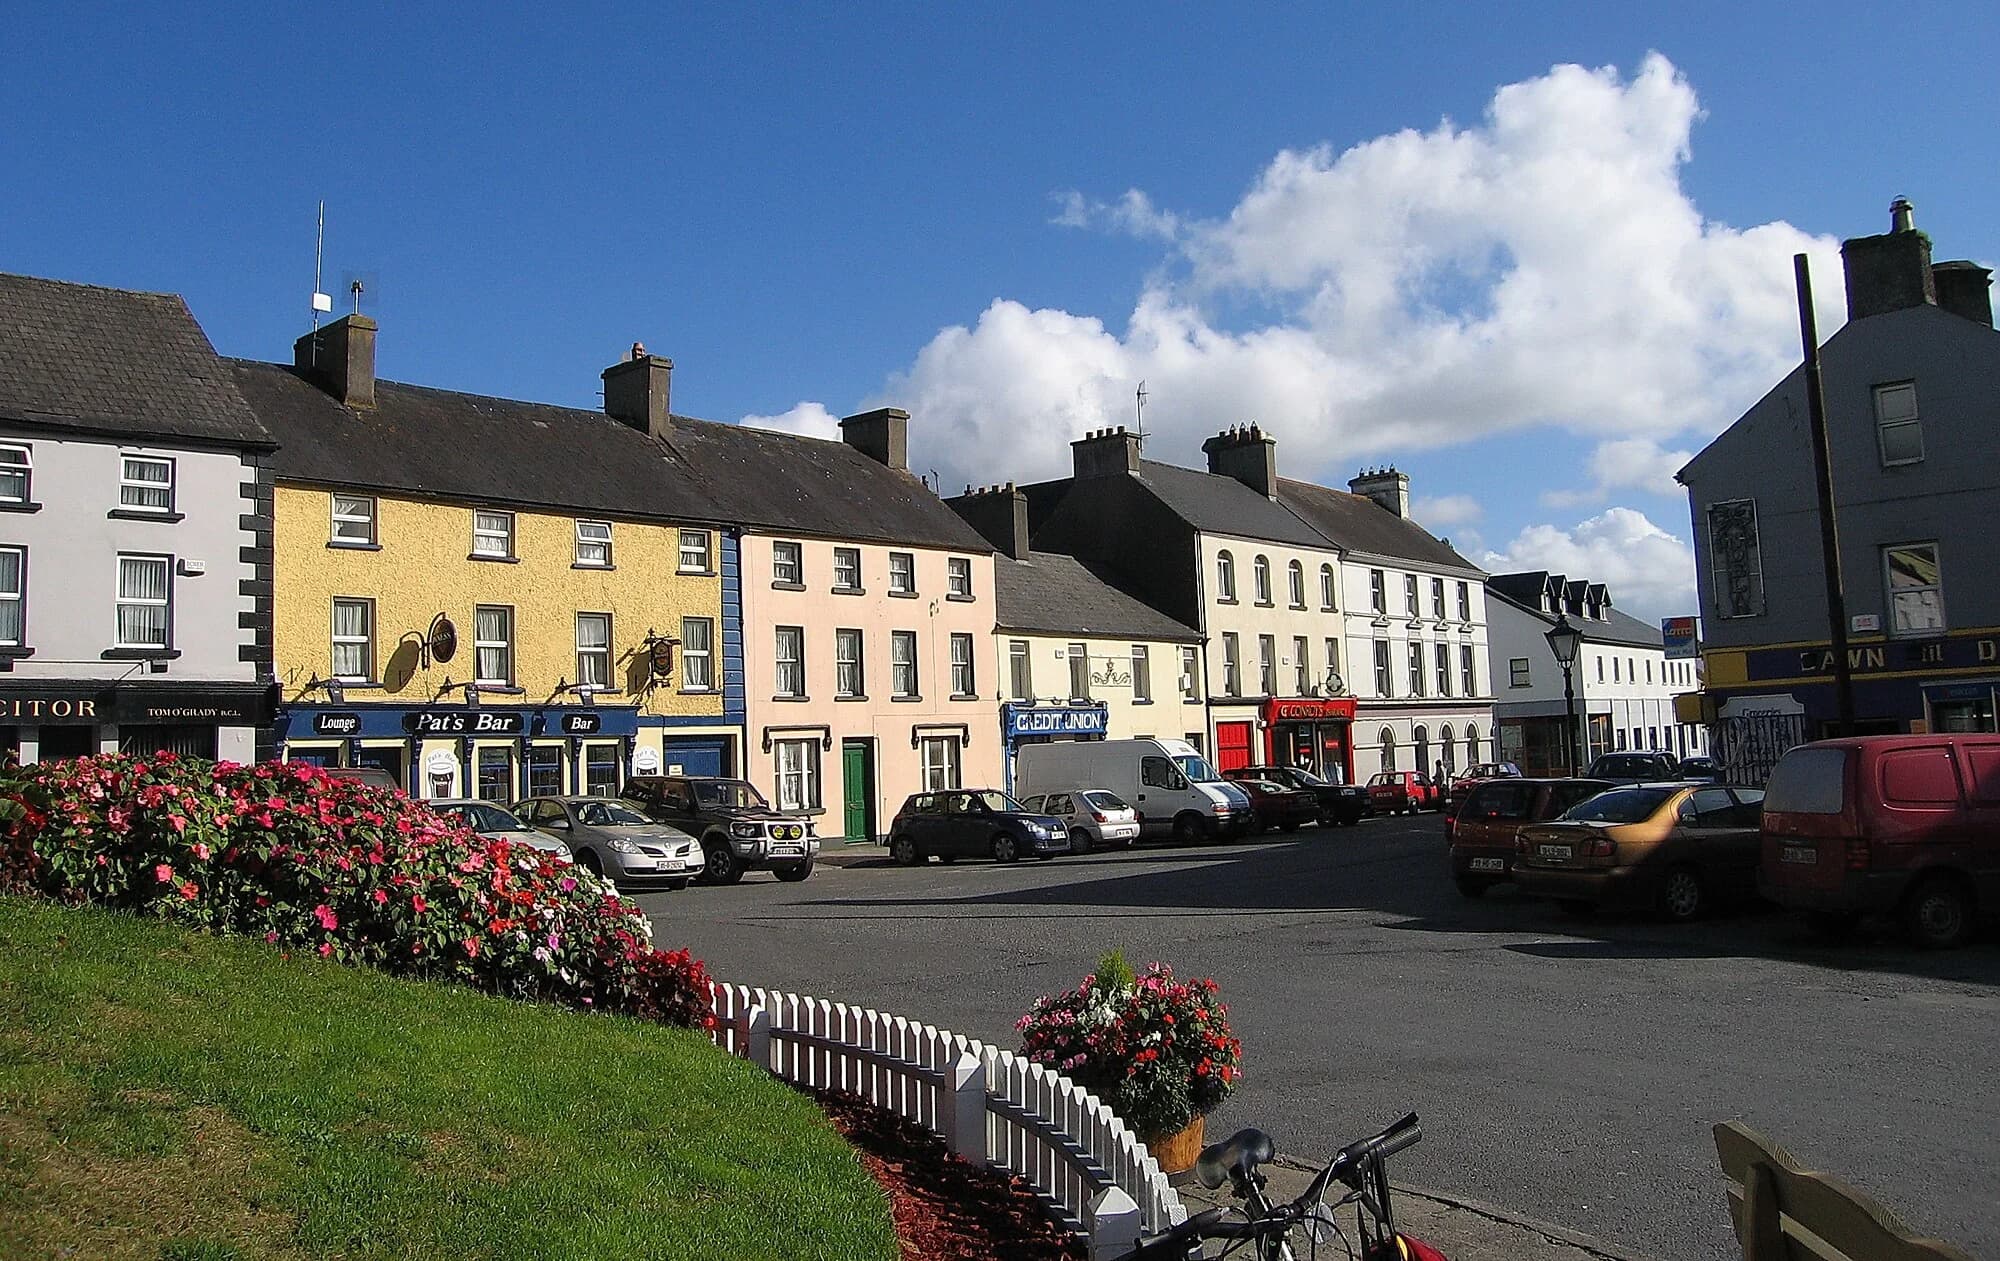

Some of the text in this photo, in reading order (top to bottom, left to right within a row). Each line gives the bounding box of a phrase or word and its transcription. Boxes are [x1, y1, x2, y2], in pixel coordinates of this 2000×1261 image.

[147, 708, 171, 717] TOM
[320, 715, 356, 732] Lounge
[415, 713, 512, 731] Pat's Bar
[570, 717, 592, 730] Bar
[1016, 713, 1101, 730] CREDIT UNION
